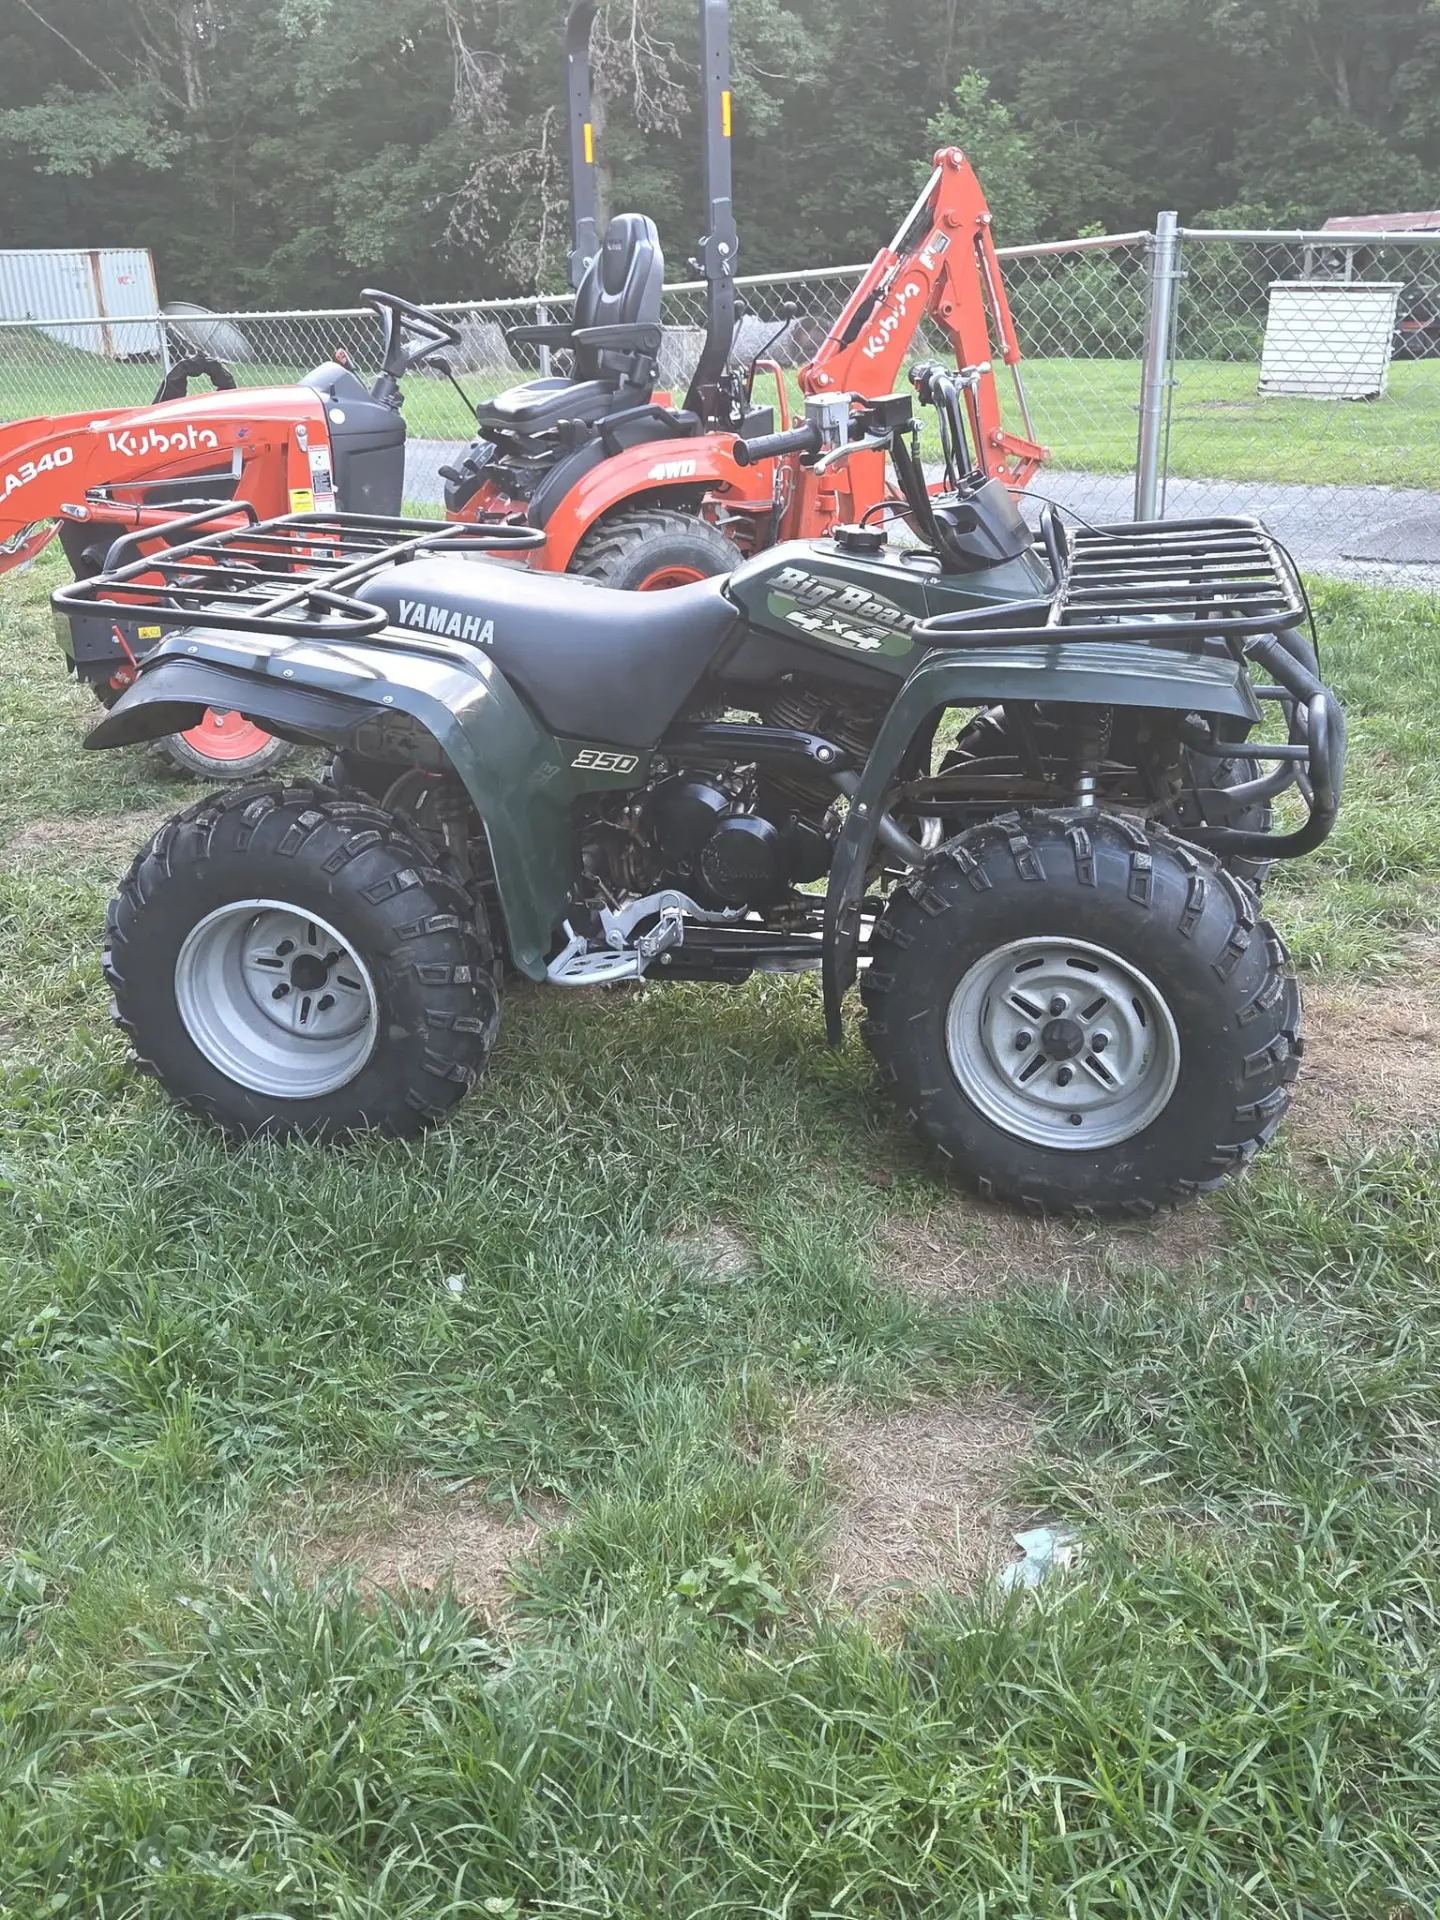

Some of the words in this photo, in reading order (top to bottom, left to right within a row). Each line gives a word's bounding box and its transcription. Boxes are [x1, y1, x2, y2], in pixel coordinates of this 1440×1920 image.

[863, 283, 920, 359] Kubota
[108, 424, 217, 456] Kubota
[647, 459, 696, 481] 4WD
[765, 566, 836, 608] Big
[829, 585, 922, 632] Bear
[398, 599, 494, 644] YAMAHA
[571, 750, 639, 773] 350
